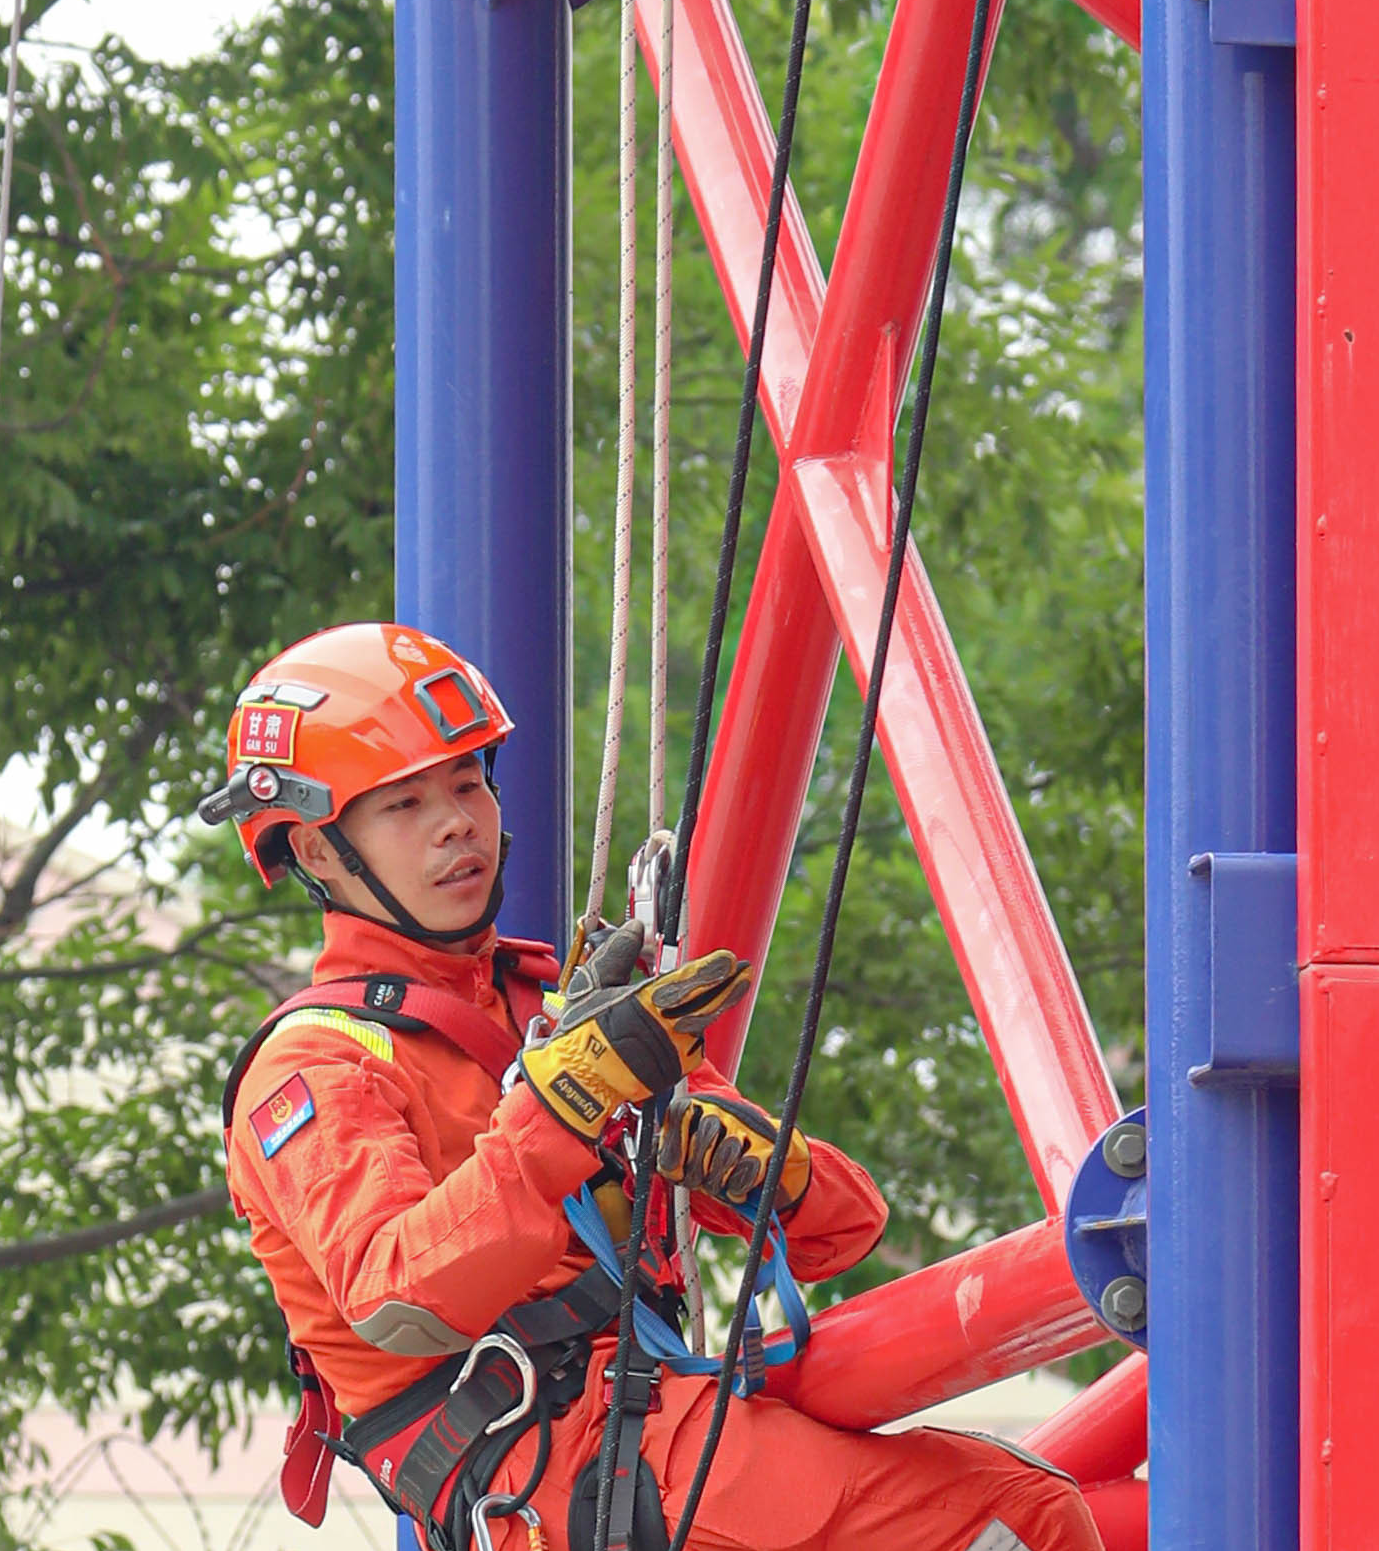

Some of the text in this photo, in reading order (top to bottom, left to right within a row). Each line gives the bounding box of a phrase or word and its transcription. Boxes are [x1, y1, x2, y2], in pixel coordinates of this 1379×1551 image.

[248, 711, 282, 740] 甘肃
[245, 738, 278, 754] GAN SU
